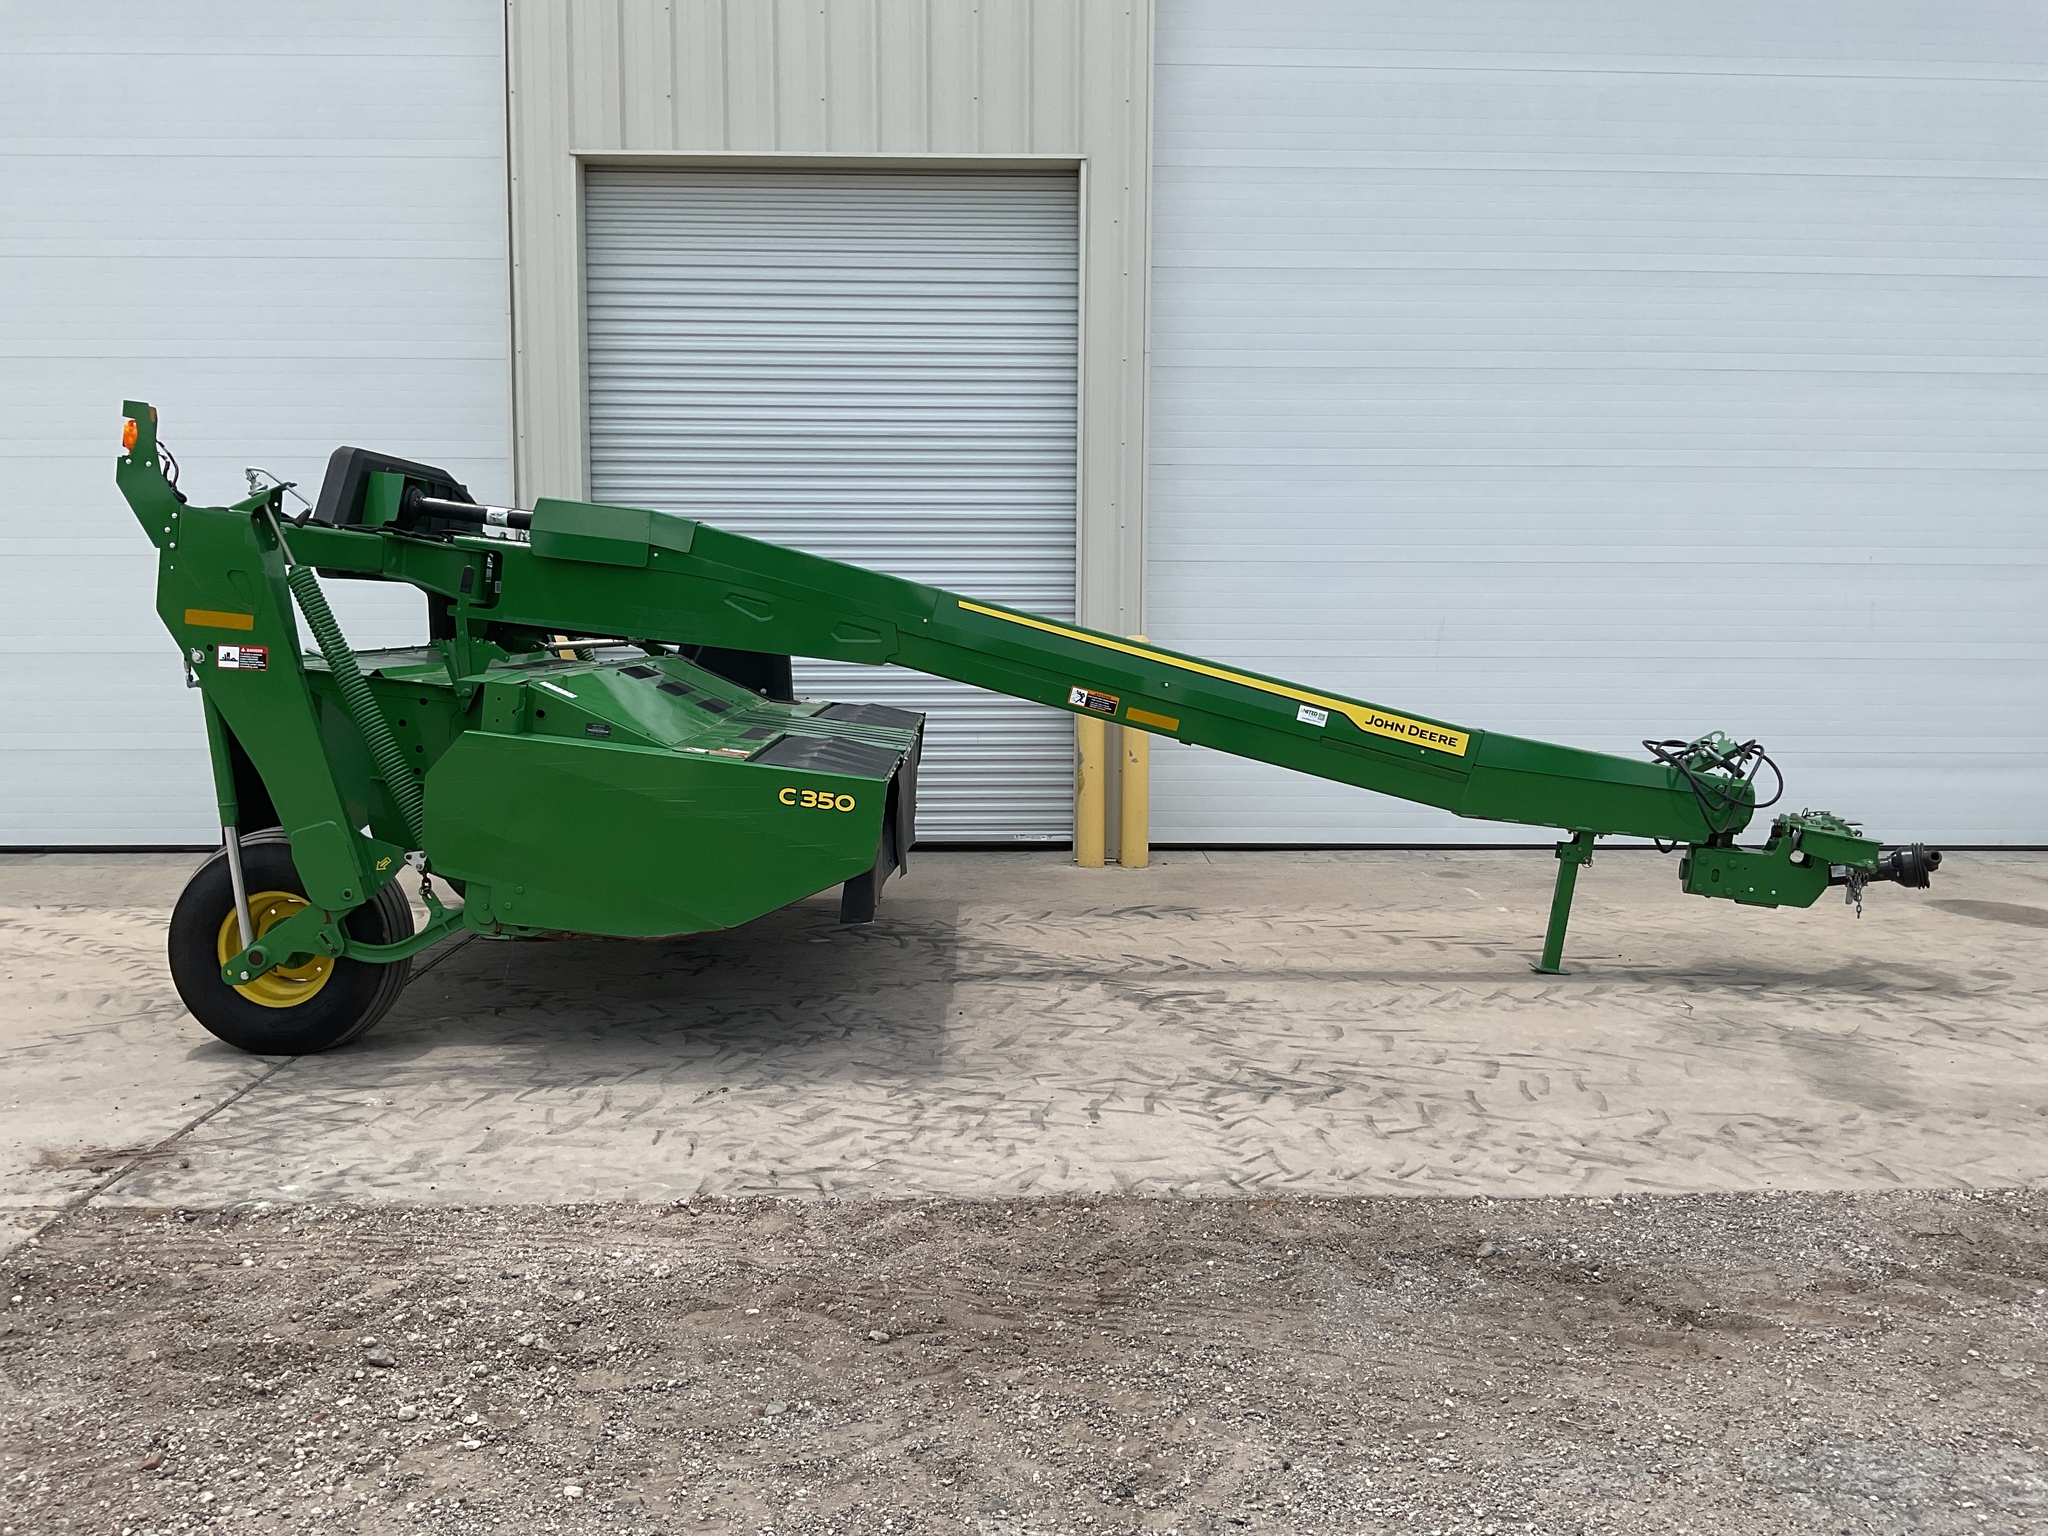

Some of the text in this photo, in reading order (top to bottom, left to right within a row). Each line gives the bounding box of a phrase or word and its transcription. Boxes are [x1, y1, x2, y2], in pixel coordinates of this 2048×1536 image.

[1365, 714, 1458, 747] JOHN DEERE
[779, 787, 856, 812] C350
